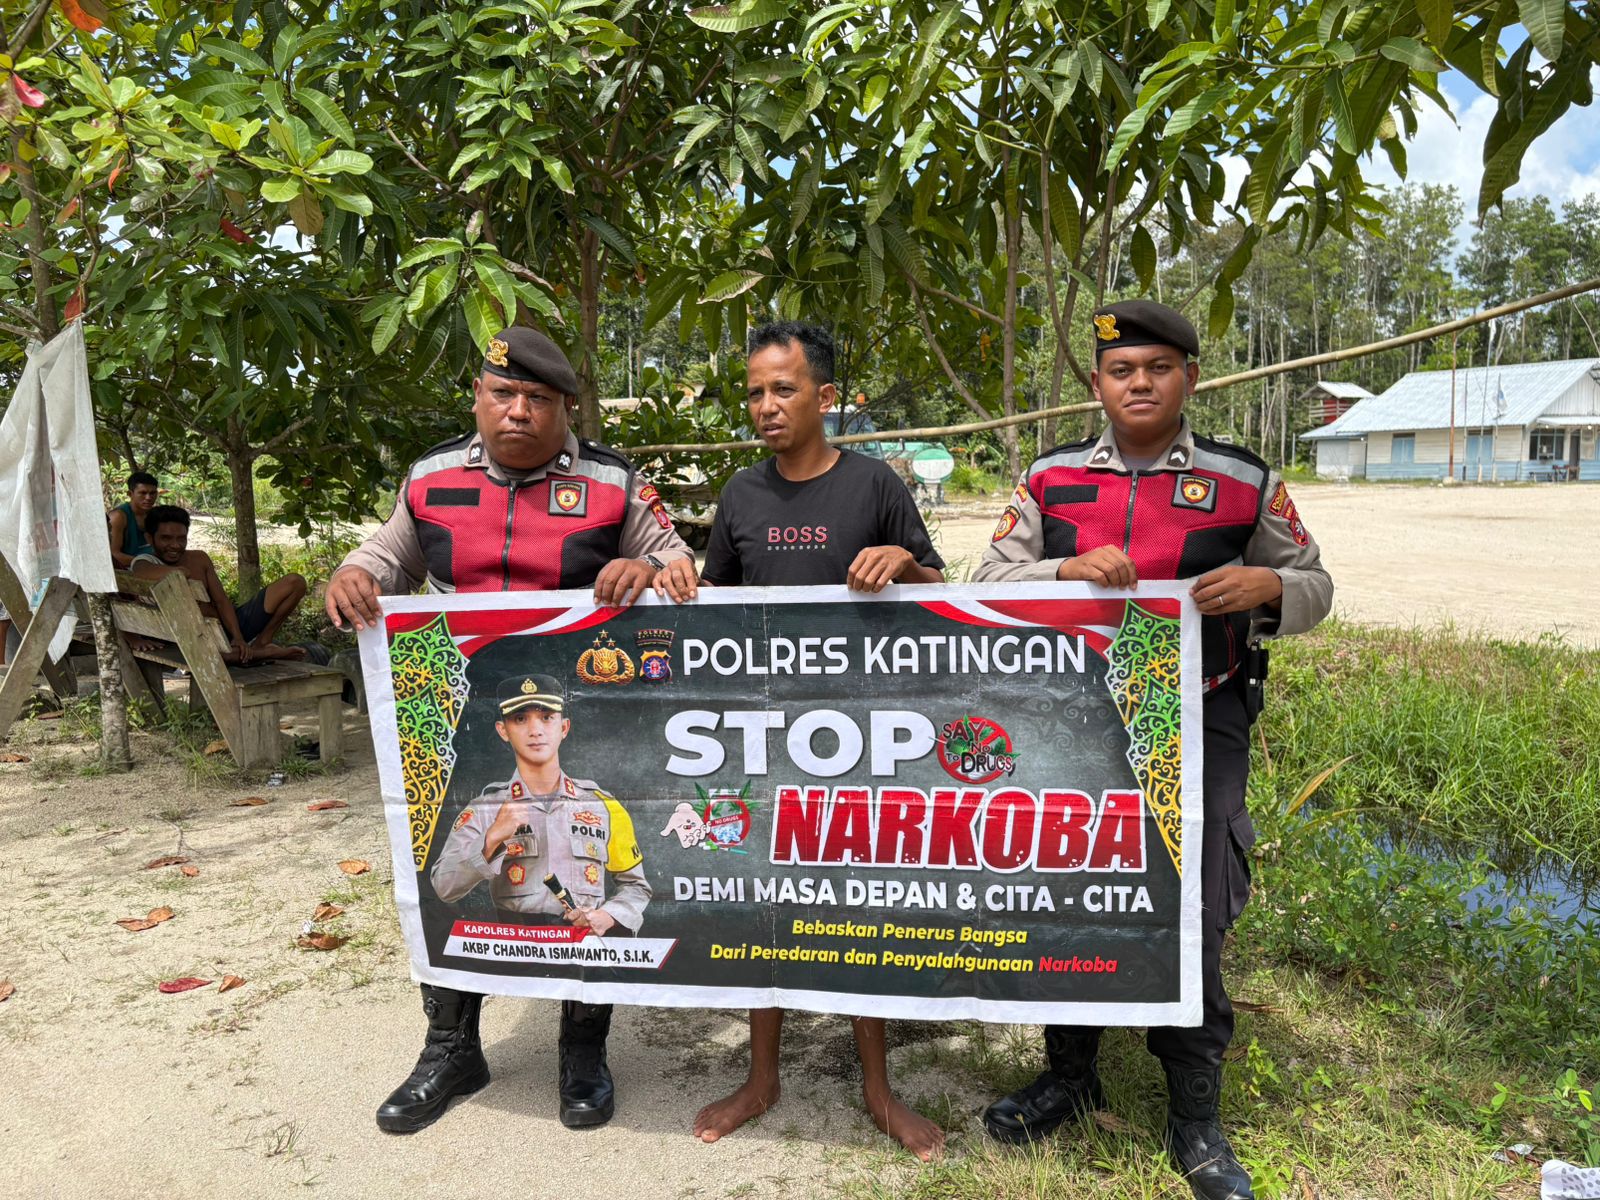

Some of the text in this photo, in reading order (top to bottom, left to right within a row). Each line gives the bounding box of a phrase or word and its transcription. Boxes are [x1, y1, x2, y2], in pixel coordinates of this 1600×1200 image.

[767, 526, 828, 543] BOSS
[683, 635, 1086, 675] POLRES KATINGAN
[665, 710, 935, 777] STOP
[943, 721, 986, 742] SAY
[571, 825, 606, 840] POLRI
[770, 784, 1147, 873] NARKOBA
[674, 876, 745, 902] DEMI
[754, 877, 837, 907] MASA
[846, 880, 947, 909] DEPAN
[957, 882, 976, 910] &
[985, 884, 1055, 912] CITA
[1083, 885, 1153, 913] CITA
[463, 924, 571, 939] KAPOLRES KATINGAN
[792, 920, 1027, 945] Bebaskan Penerus Bangsa
[462, 942, 654, 963] AKBP CHANDRA ISMAWANTO, S.I.K.
[710, 944, 1117, 973] Dari Peredaran dan Penyalahgunaan Narkoba
